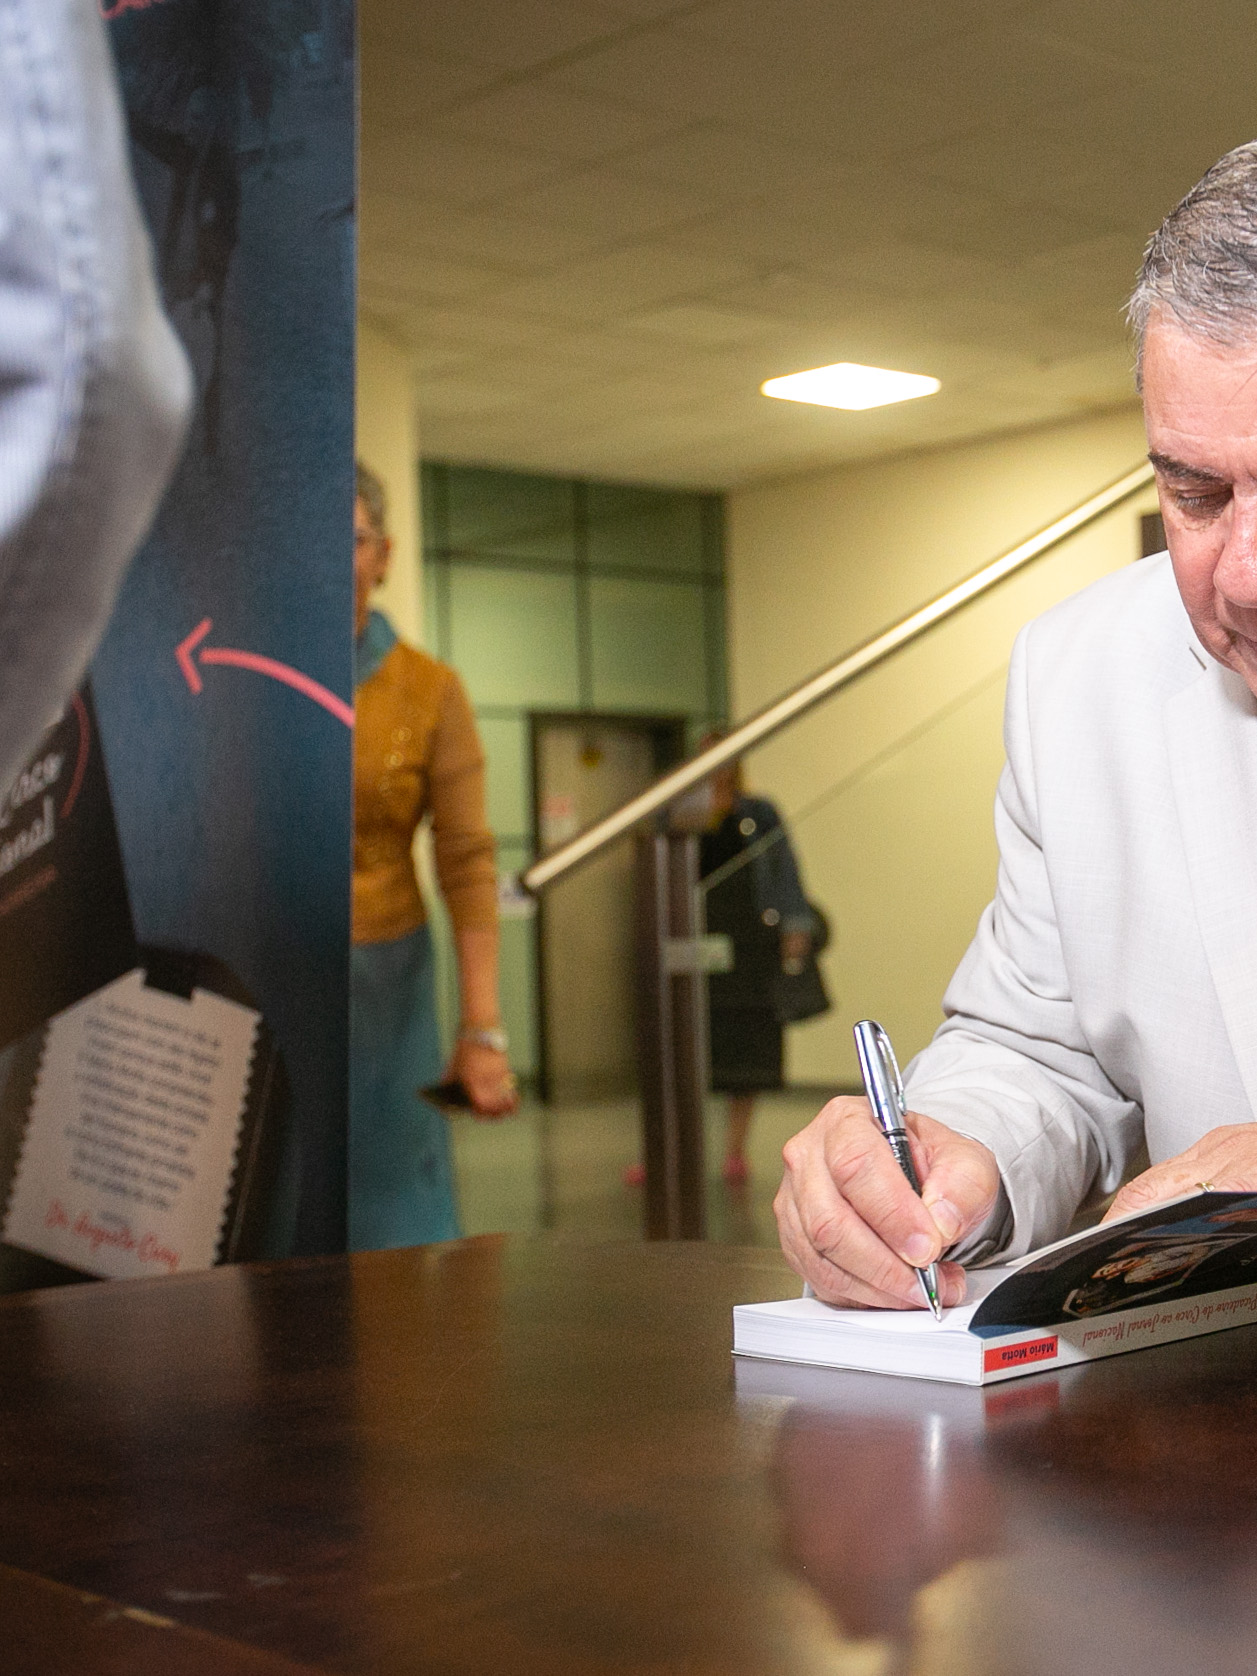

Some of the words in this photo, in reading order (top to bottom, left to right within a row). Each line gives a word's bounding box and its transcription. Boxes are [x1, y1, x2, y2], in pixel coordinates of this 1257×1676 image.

[1216, 1293, 1257, 1314] Picadeiro
[1161, 1313, 1173, 1324] ao
[1175, 1305, 1200, 1324] Circo
[1202, 1305, 1214, 1320] do
[1083, 1321, 1125, 1347] Nacional
[1126, 1314, 1160, 1338] Jornal
[1002, 1348, 1027, 1361] Motta
[1029, 1341, 1055, 1356] Mário
